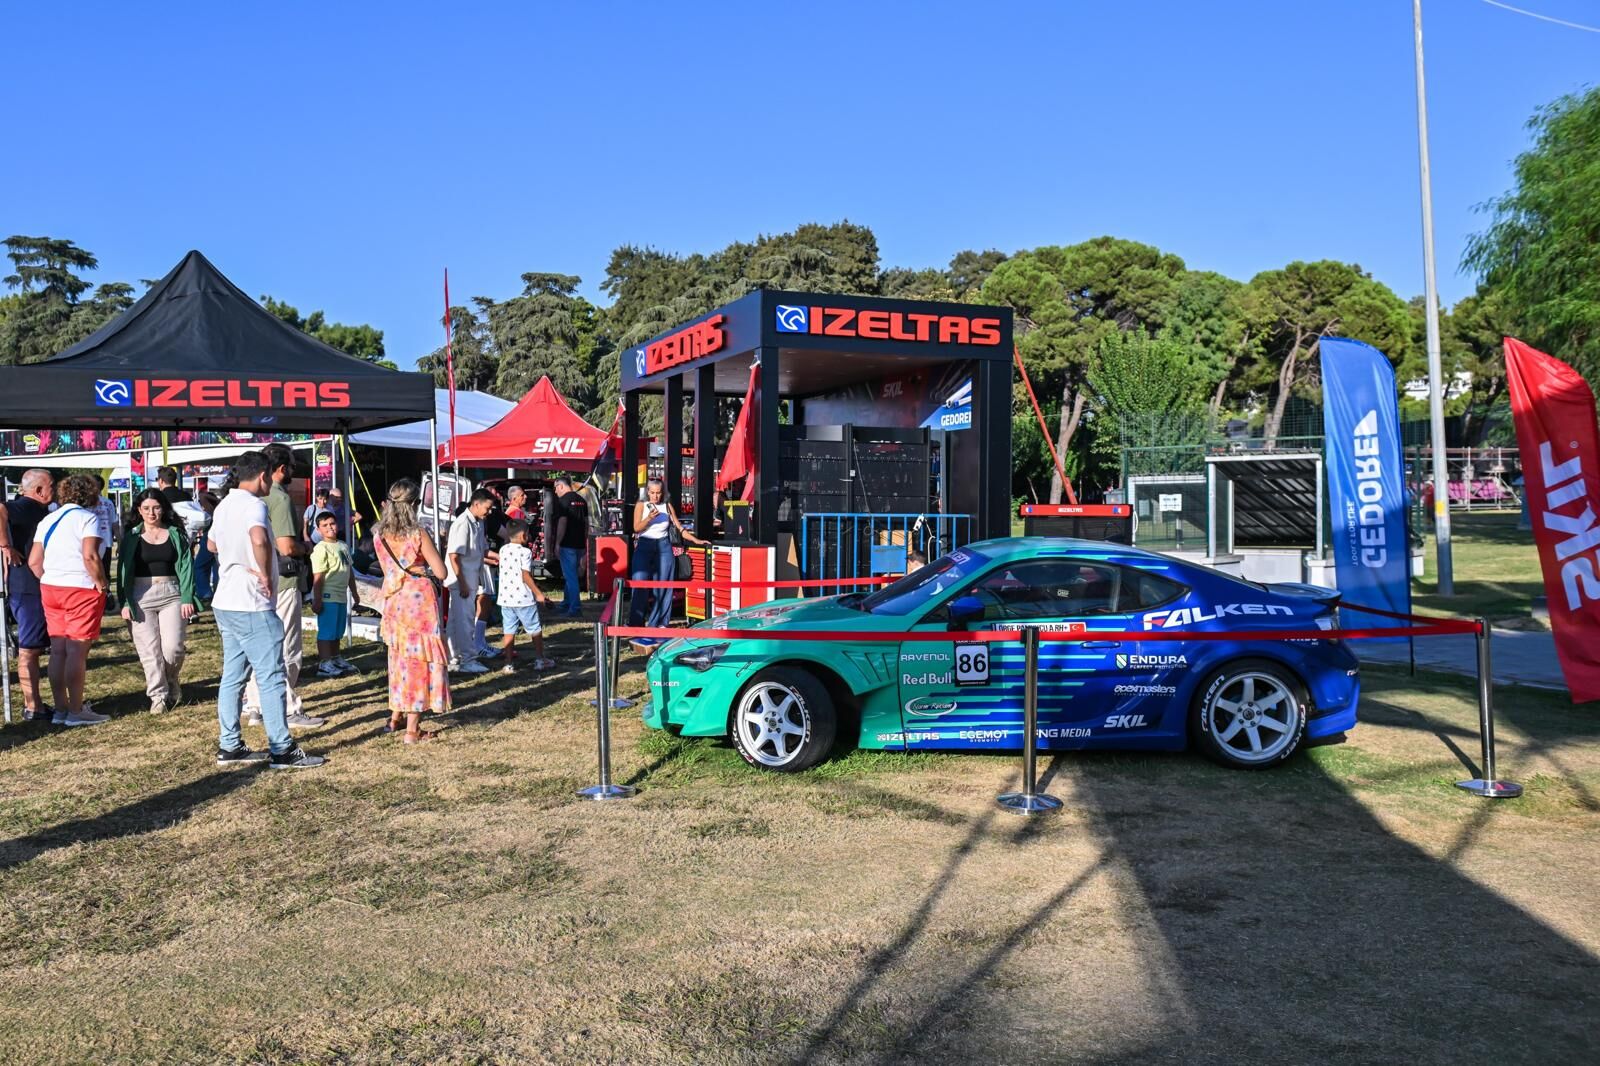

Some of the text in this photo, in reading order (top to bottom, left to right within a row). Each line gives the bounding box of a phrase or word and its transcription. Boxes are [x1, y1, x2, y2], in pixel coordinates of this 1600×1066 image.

[809, 306, 1001, 345] IZELTAS
[135, 379, 351, 408] IZELTAS
[532, 437, 584, 454] SKIL
[1143, 604, 1294, 631] FALKEN
[901, 653, 951, 661] RAVENOL
[959, 653, 987, 673] 86
[1130, 655, 1187, 664] ENDURA
[903, 672, 952, 684] Red Bull
[1104, 715, 1148, 728] SKIL
[960, 730, 1008, 738] EGEMOT
[1060, 728, 1092, 738] MEDIA
